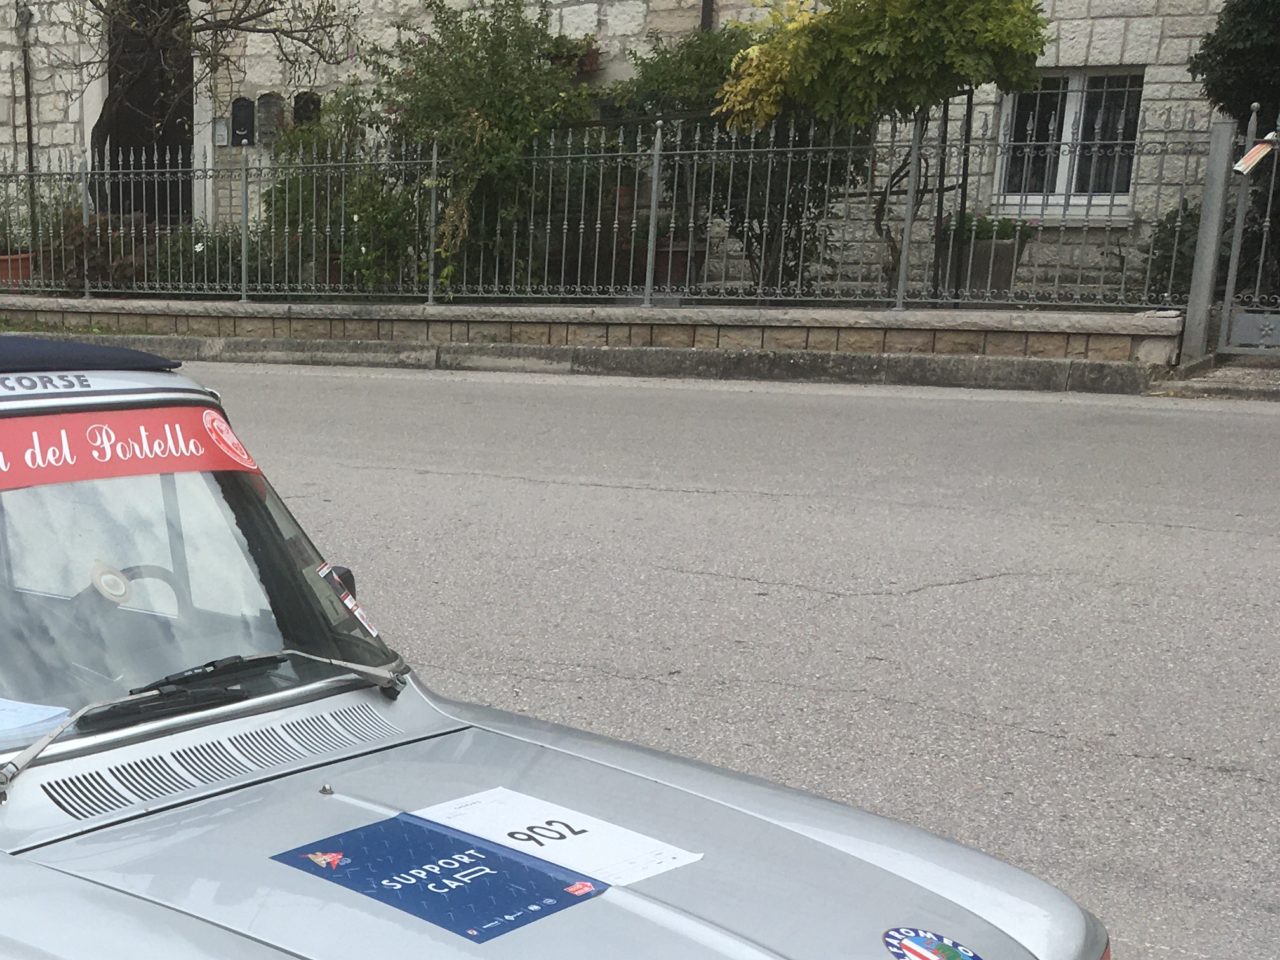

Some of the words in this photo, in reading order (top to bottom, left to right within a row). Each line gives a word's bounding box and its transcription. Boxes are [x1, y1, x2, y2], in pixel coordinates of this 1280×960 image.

[24, 428, 77, 469] del
[85, 423, 205, 463] Portello
[507, 819, 589, 848] 902
[380, 849, 486, 891] SUPPORT
[428, 866, 498, 894] CAR
